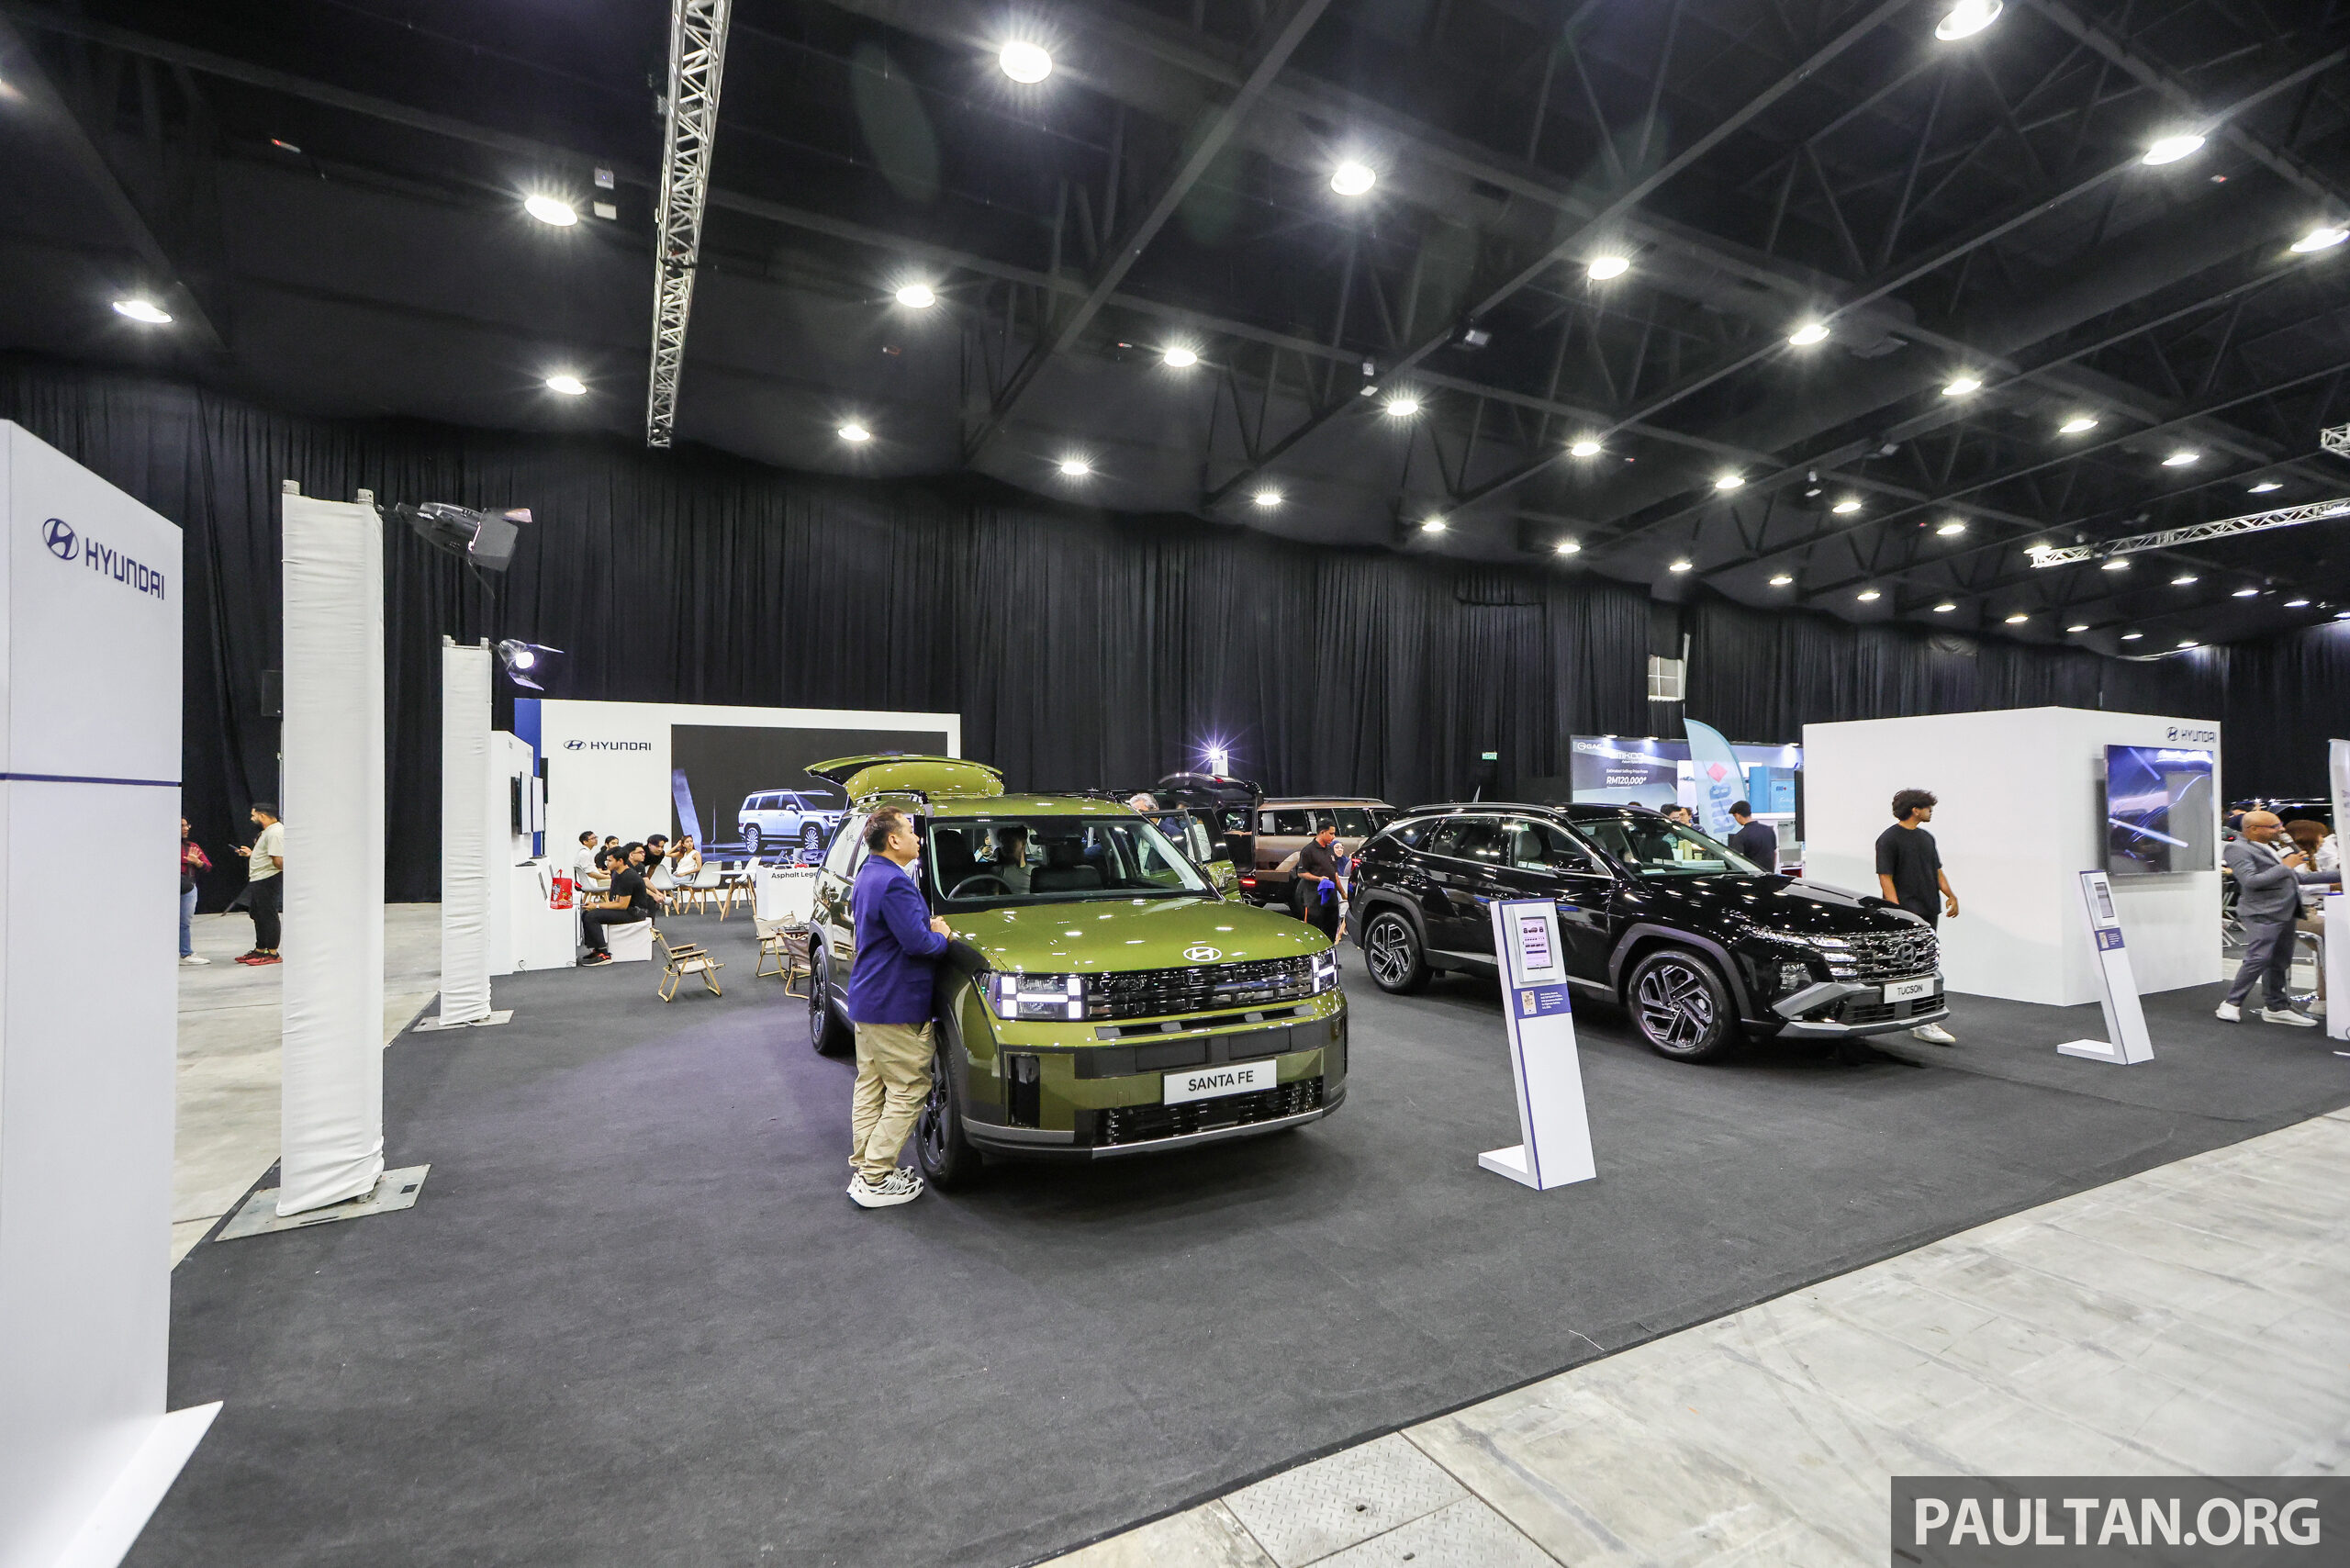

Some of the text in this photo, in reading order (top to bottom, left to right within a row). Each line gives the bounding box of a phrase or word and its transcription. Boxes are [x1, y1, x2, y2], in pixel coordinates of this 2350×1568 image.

[85, 537, 164, 600] HYUNDAI
[2182, 729, 2217, 743] HYUNDAI
[590, 741, 652, 751] HYUNDAI
[771, 871, 800, 879] Asphalt
[1897, 983, 1923, 996] TUCSON
[1188, 1070, 1254, 1092] SANTA FE
